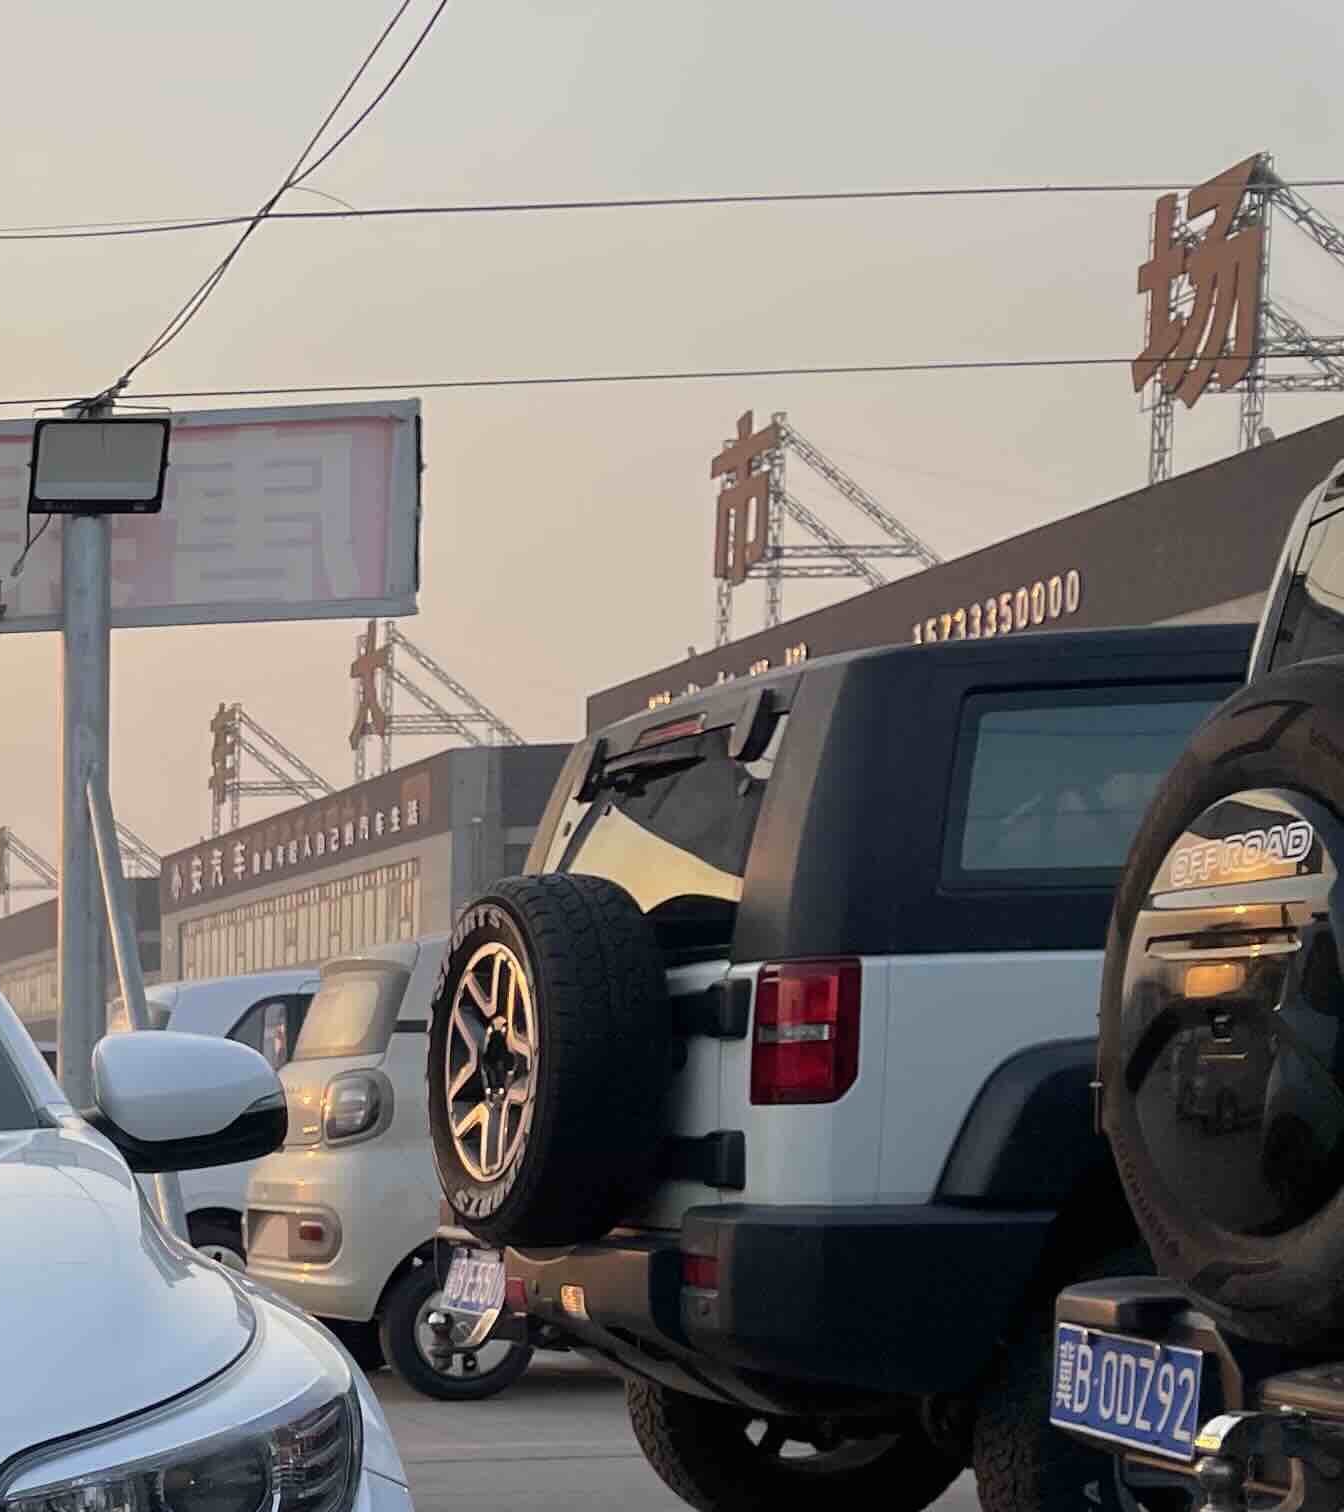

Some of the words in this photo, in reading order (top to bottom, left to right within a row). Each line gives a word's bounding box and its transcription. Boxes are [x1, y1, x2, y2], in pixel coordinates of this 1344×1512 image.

[712, 410, 780, 585] 市
[1132, 153, 1265, 408] 场
[1169, 840, 1218, 887] OFF
[1218, 820, 1314, 873] ROAD
